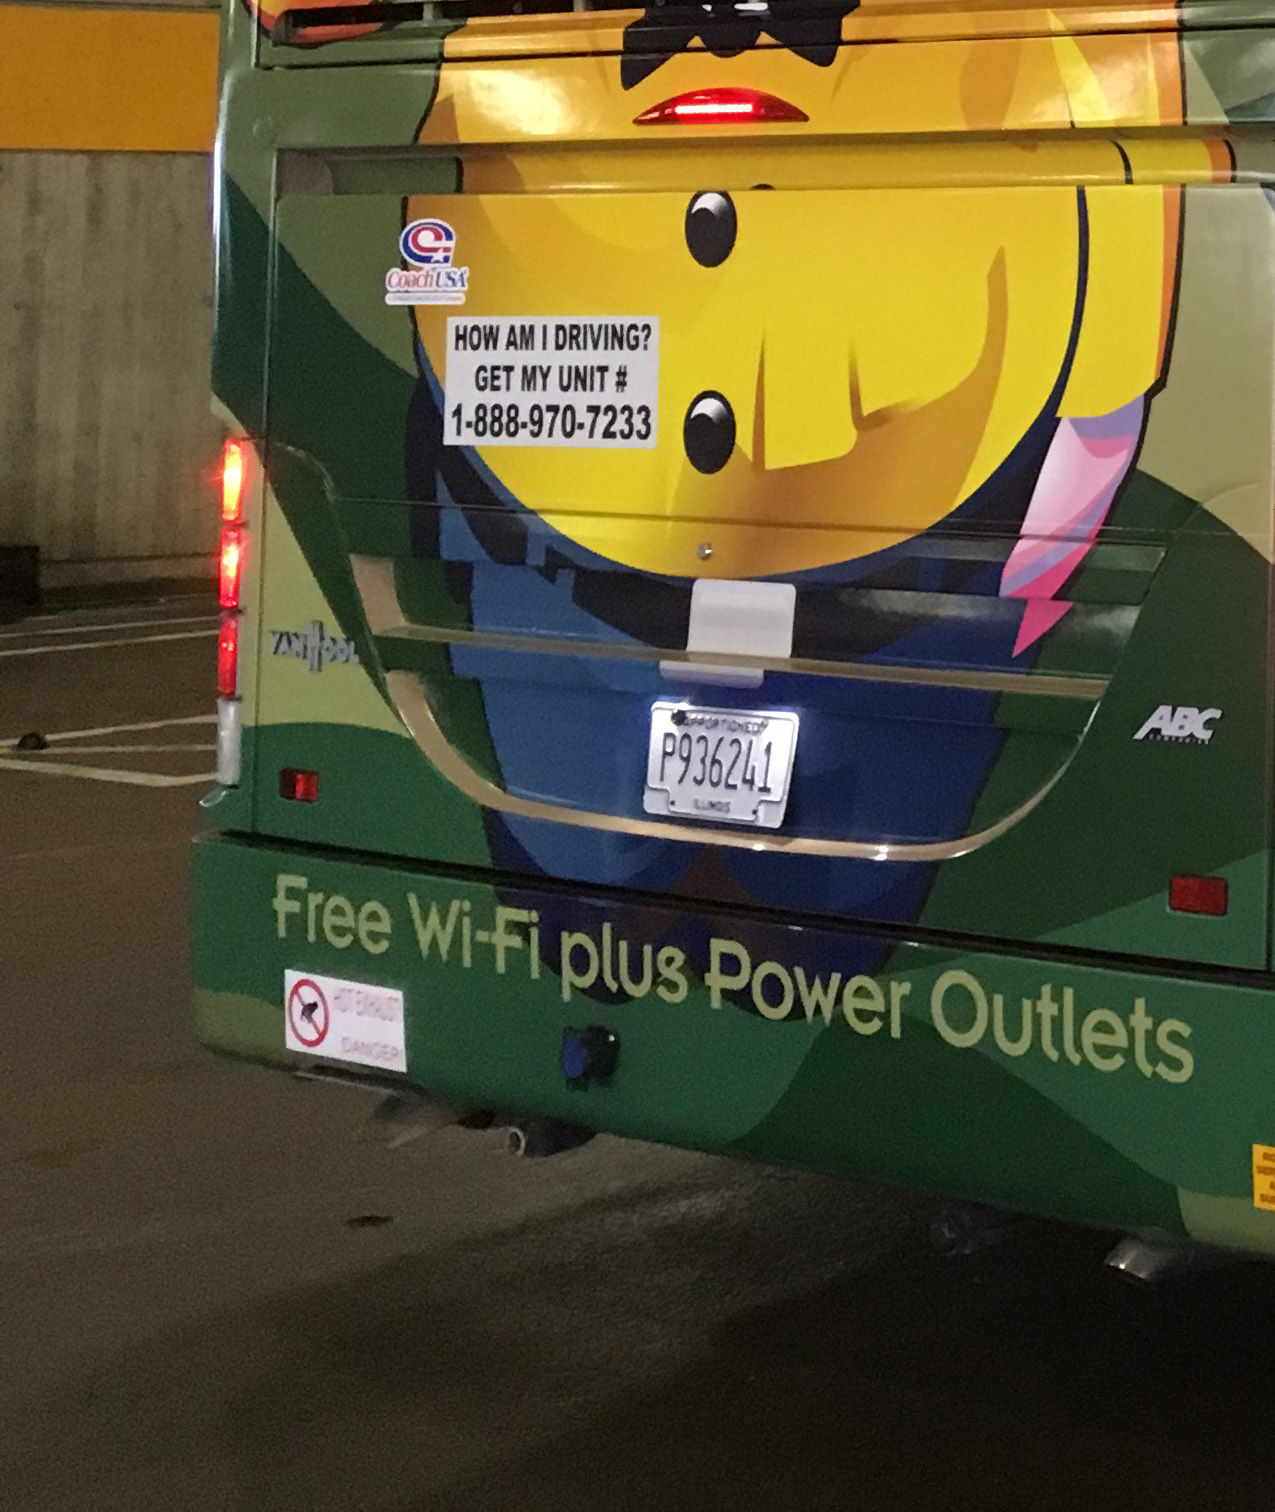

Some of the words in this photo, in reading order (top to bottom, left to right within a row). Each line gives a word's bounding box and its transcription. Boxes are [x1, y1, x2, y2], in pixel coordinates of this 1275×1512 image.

[454, 324, 500, 351] HOW
[505, 324, 535, 351] AM
[542, 324, 548, 351] I
[554, 323, 652, 352] DRIVING?
[475, 364, 514, 392] GET
[521, 365, 552, 392] MY
[558, 365, 609, 392] UNIT
[615, 365, 628, 393] #
[451, 402, 652, 441] 1-888-970-7233
[1132, 704, 1223, 741] ABC
[659, 732, 772, 793] P936241
[272, 873, 392, 955] Free
[406, 891, 541, 980] Wi-Fi
[560, 921, 688, 1004] plus
[704, 937, 912, 1039] Power
[930, 969, 1196, 1084] Outlets
